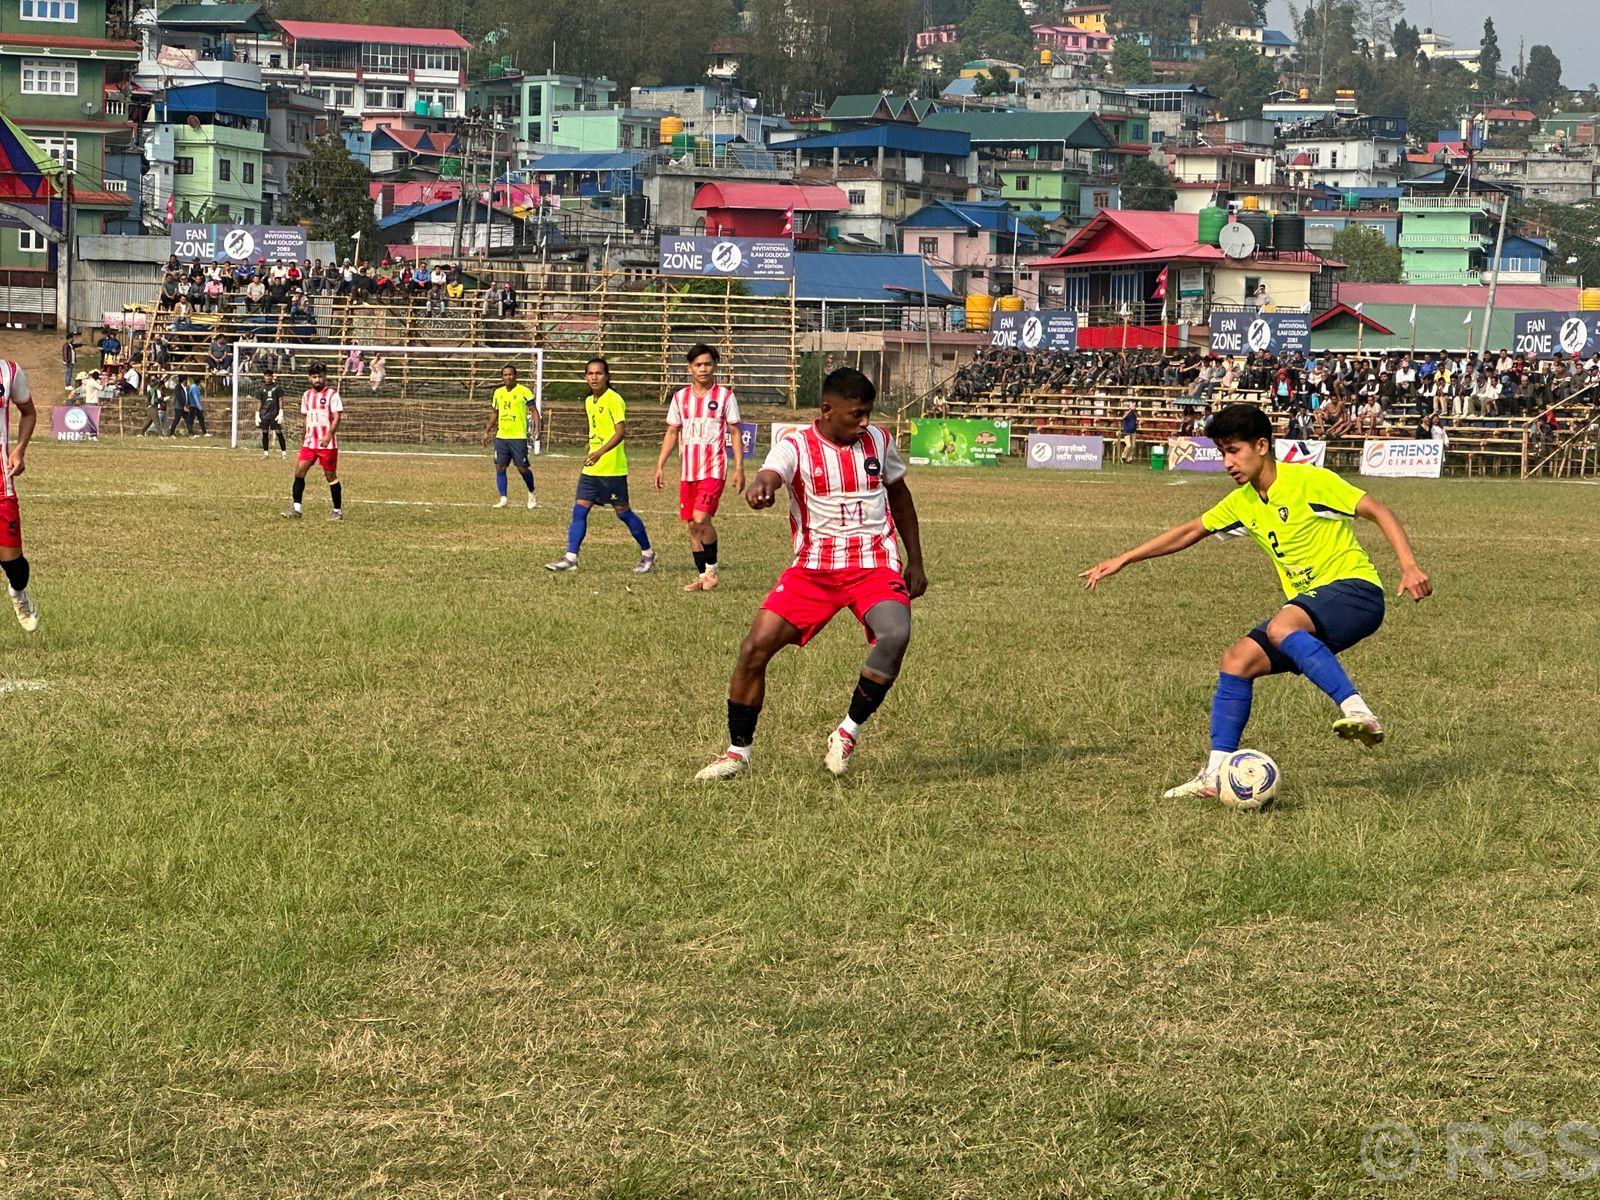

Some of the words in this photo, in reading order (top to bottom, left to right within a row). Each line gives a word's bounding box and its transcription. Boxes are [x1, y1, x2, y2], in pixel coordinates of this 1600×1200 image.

[185, 228, 207, 240] FAN
[174, 241, 214, 258] ZONE
[674, 241, 695, 253] FAN
[662, 253, 703, 270] ZONE
[1000, 316, 1014, 329] FAN
[1221, 318, 1237, 332] FAN
[1526, 318, 1546, 334] FAN
[991, 330, 1018, 347] ZONE
[1211, 333, 1242, 351] ZONE
[1515, 334, 1552, 353] ZONE
[1389, 444, 1440, 457] FRIENDS
[1388, 457, 1439, 466] CINEMAS
[839, 500, 864, 527] M
[1267, 530, 1285, 558] 2
